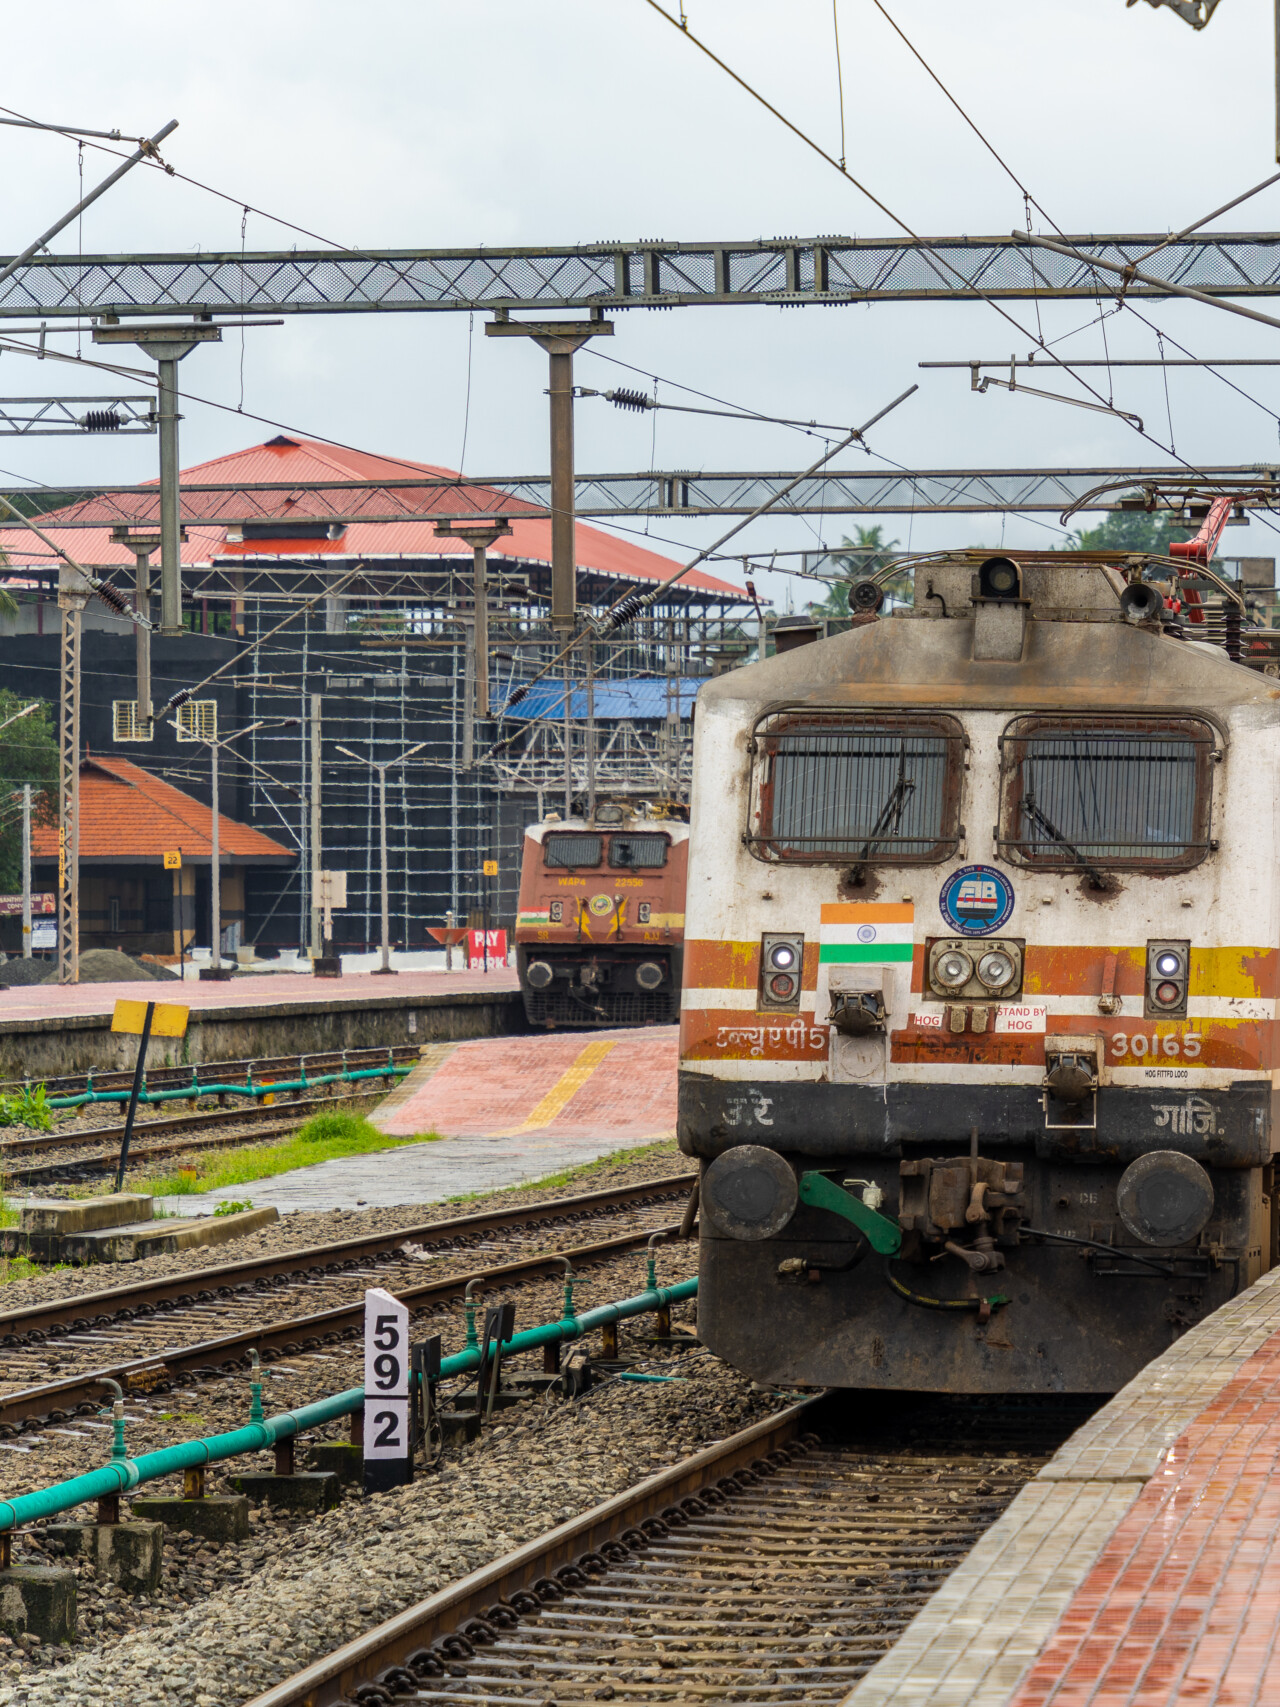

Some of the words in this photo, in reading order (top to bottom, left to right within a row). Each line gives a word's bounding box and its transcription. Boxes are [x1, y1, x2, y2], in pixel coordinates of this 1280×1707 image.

[168, 856, 177, 864] 22
[558, 877, 586, 886] WAP4
[474, 931, 499, 948] PAY
[537, 930, 549, 940] SR
[470, 957, 505, 969] PARK
[998, 1007, 1031, 1017] STAND
[1033, 1008, 1046, 1017] BY
[914, 1015, 940, 1026] HOG
[1007, 1020, 1033, 1030] HOG
[1111, 1032, 1202, 1057] 30165
[1145, 1069, 1156, 1078] HOG
[1174, 1070, 1188, 1079] LOCO
[374, 1315, 400, 1390] 59
[374, 1411, 400, 1448] 2
